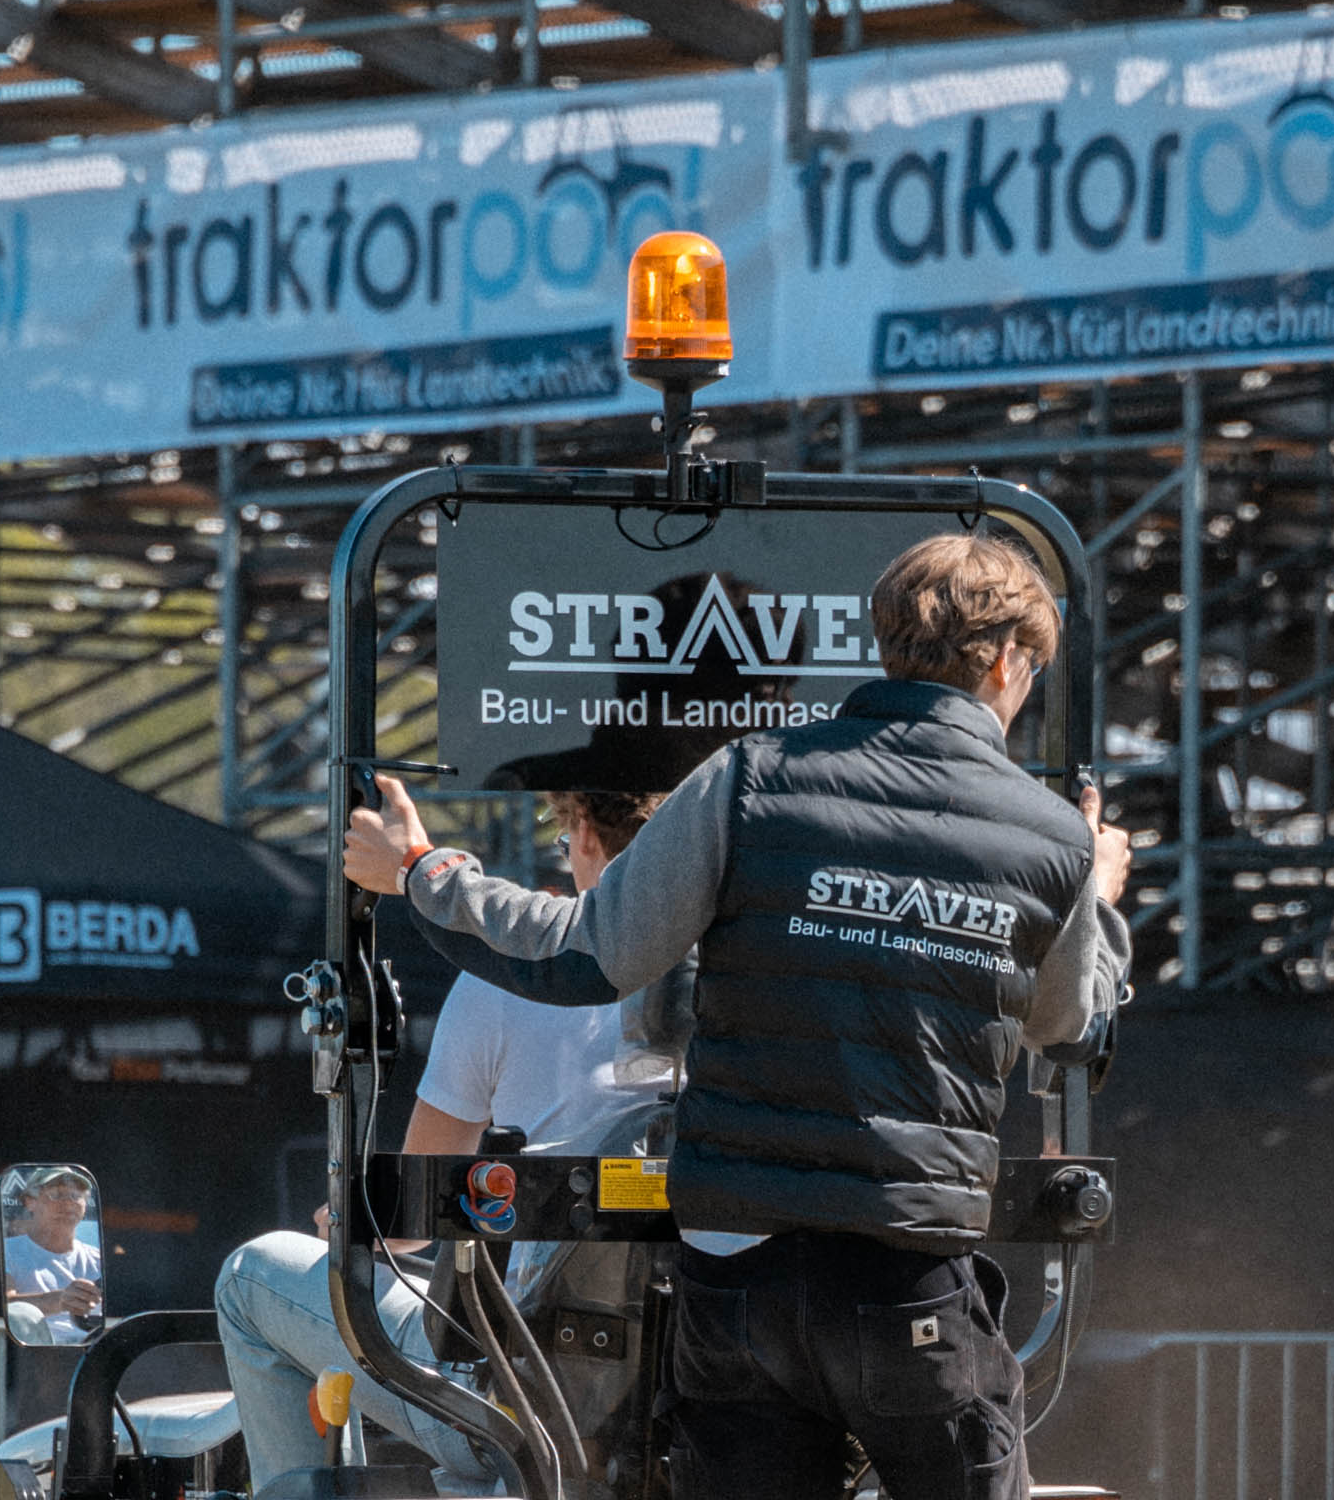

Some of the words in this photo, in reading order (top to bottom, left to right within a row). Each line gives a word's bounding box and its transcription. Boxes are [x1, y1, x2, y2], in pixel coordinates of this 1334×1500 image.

[128, 145, 703, 334] traktorpool
[884, 319, 997, 369] Deine
[1069, 307, 1125, 358] für
[481, 688, 568, 725] Bau-
[580, 691, 648, 727] und
[46, 901, 200, 957] BERDA
[807, 871, 1018, 941] STRAVER
[787, 916, 835, 938] Bau-
[839, 923, 875, 946] und
[880, 930, 1016, 976] Landmaschinen
